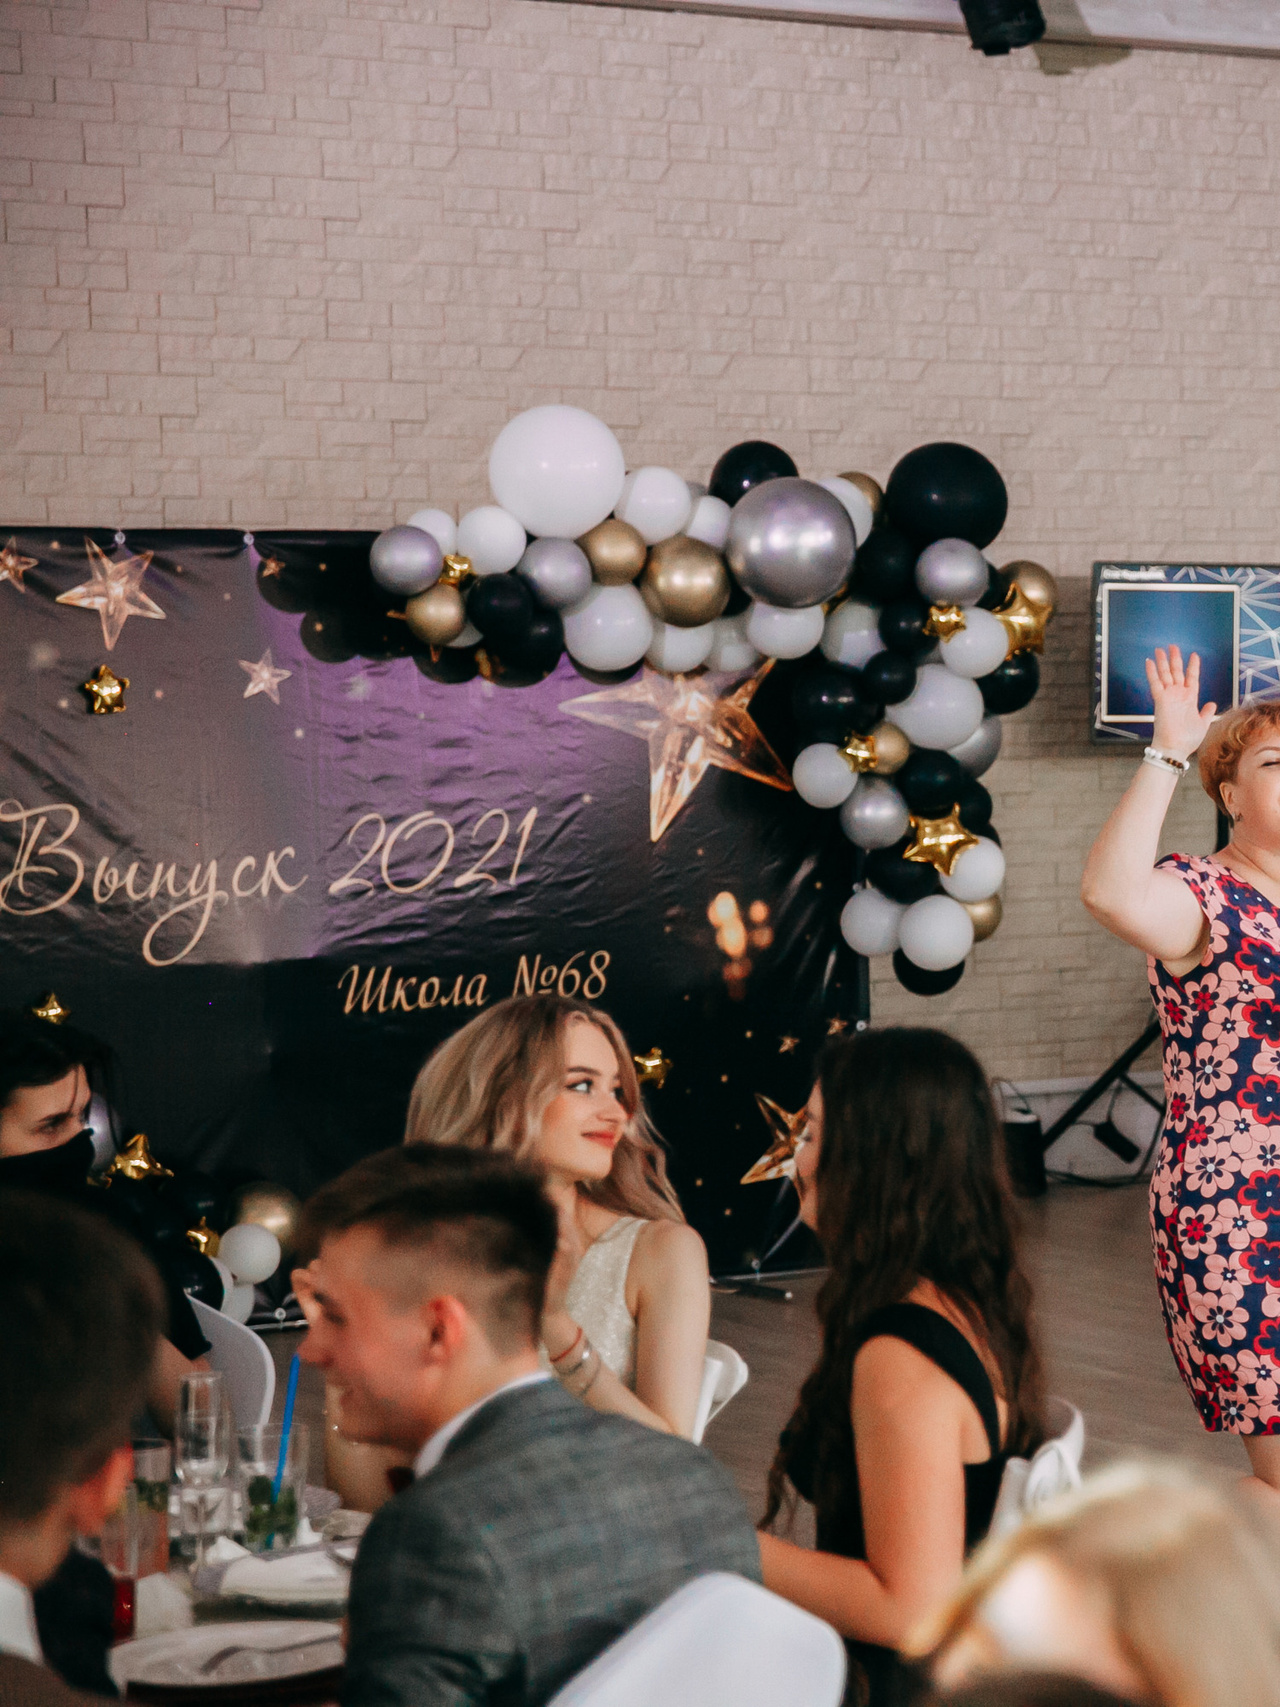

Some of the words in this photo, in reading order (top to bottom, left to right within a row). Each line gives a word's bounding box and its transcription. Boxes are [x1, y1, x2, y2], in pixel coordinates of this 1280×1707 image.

[0, 799, 309, 967] Выпуск
[328, 806, 539, 896] 2021
[337, 964, 490, 1014] Школа
[513, 949, 611, 999] №68
